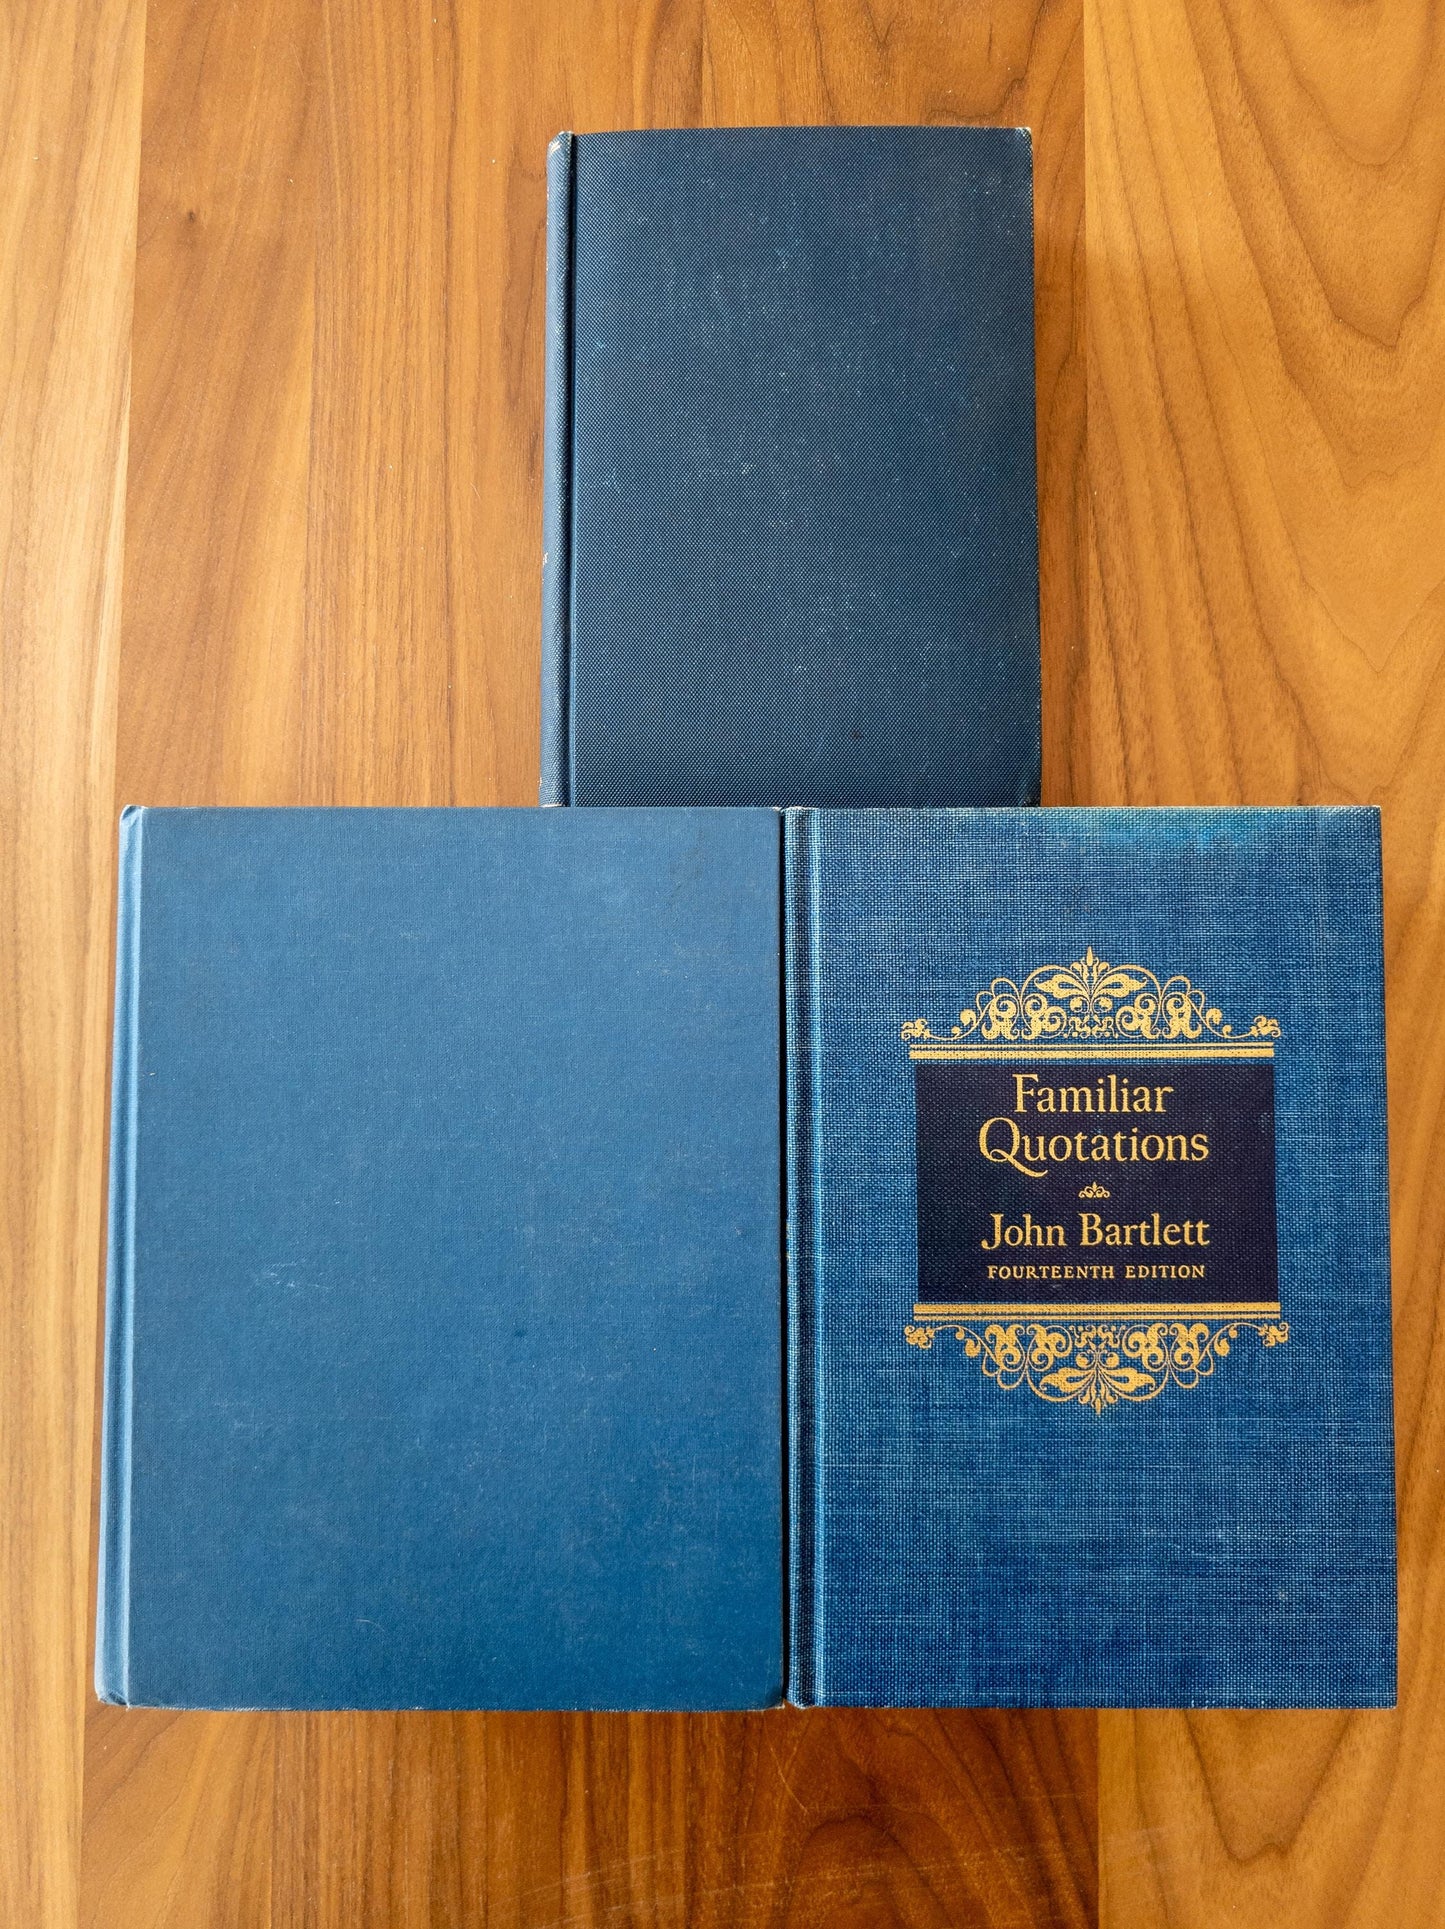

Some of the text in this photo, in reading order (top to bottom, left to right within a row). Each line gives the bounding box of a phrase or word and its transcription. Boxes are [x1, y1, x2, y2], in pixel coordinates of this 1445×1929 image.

[1012, 1073, 1174, 1112] Familiar
[979, 1117, 1209, 1177] Quotations
[981, 1213, 1210, 1249] John Bartlett
[987, 1265, 1205, 1280] FOURTEENTH EDITION
